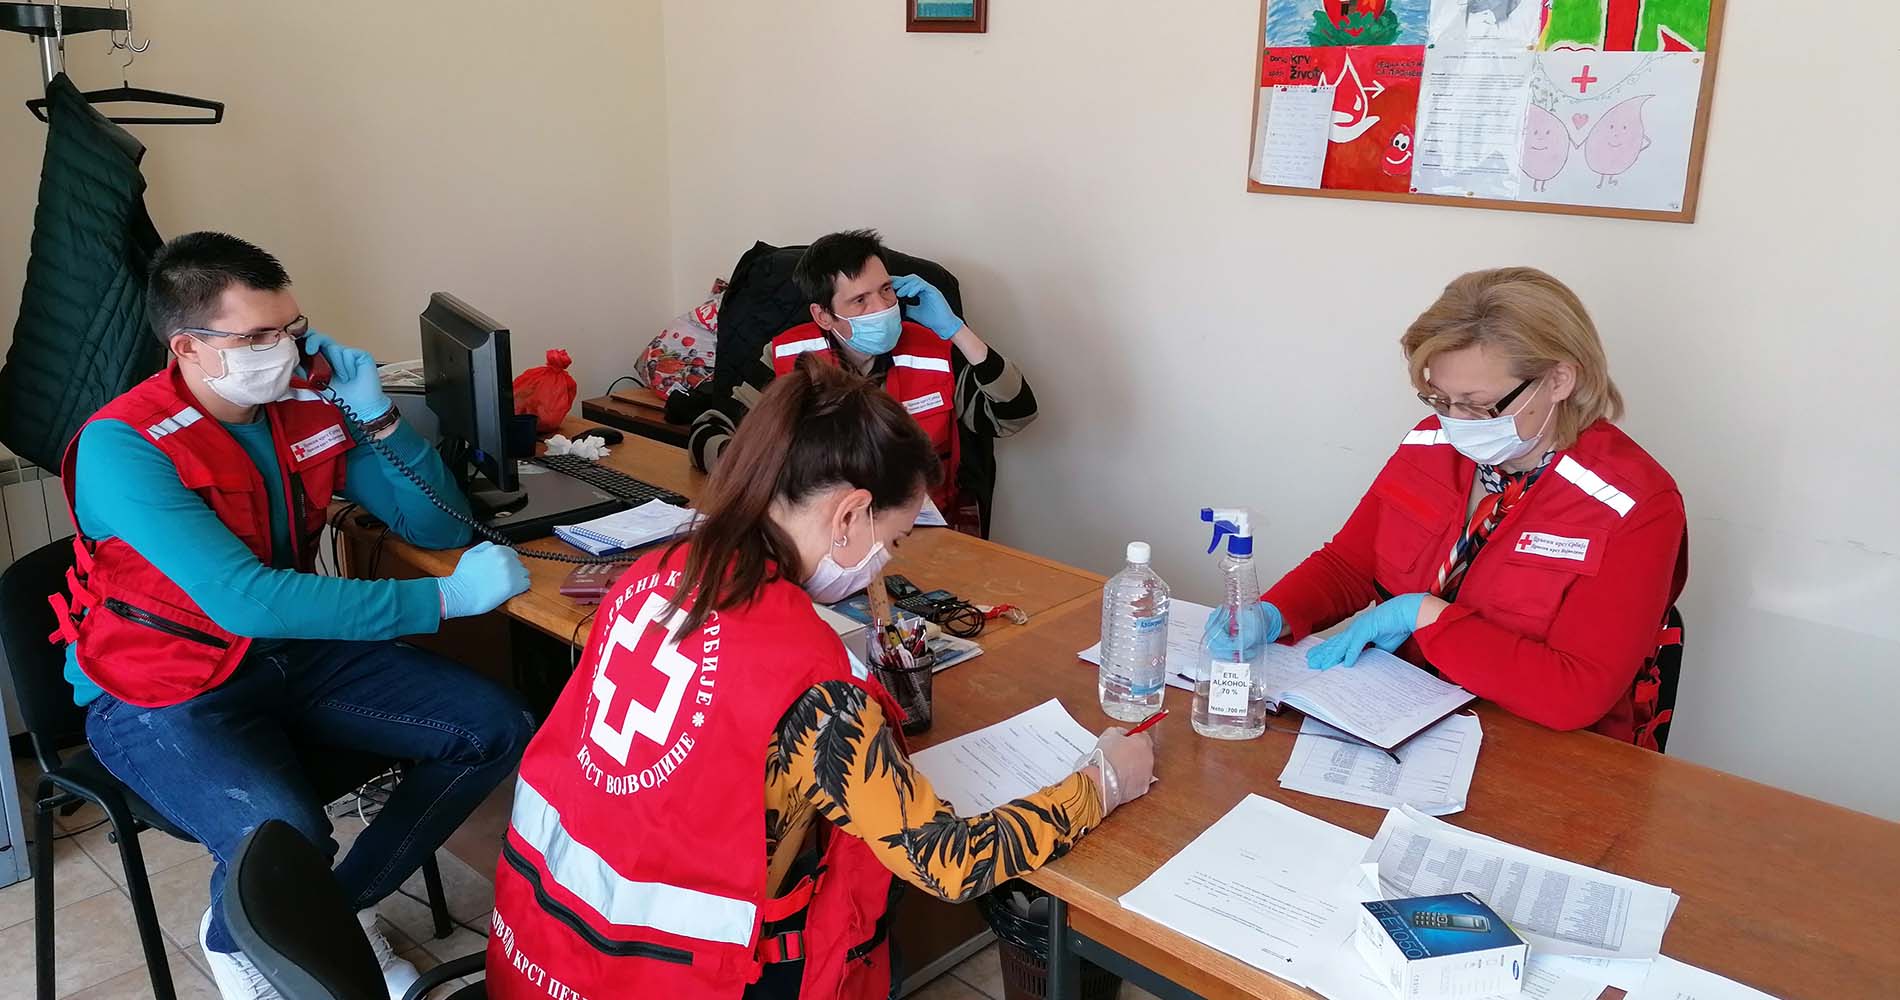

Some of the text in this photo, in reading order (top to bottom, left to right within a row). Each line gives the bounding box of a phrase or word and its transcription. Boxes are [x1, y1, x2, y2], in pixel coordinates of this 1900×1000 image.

[1213, 679, 1248, 688] ALKOHOL
[576, 731, 696, 796] КРСТ ВОЈВОДИНЕ
[1364, 902, 1424, 959] GT-E1050
[512, 949, 546, 988] КРСТ
[547, 977, 592, 1000] ПЕТ
